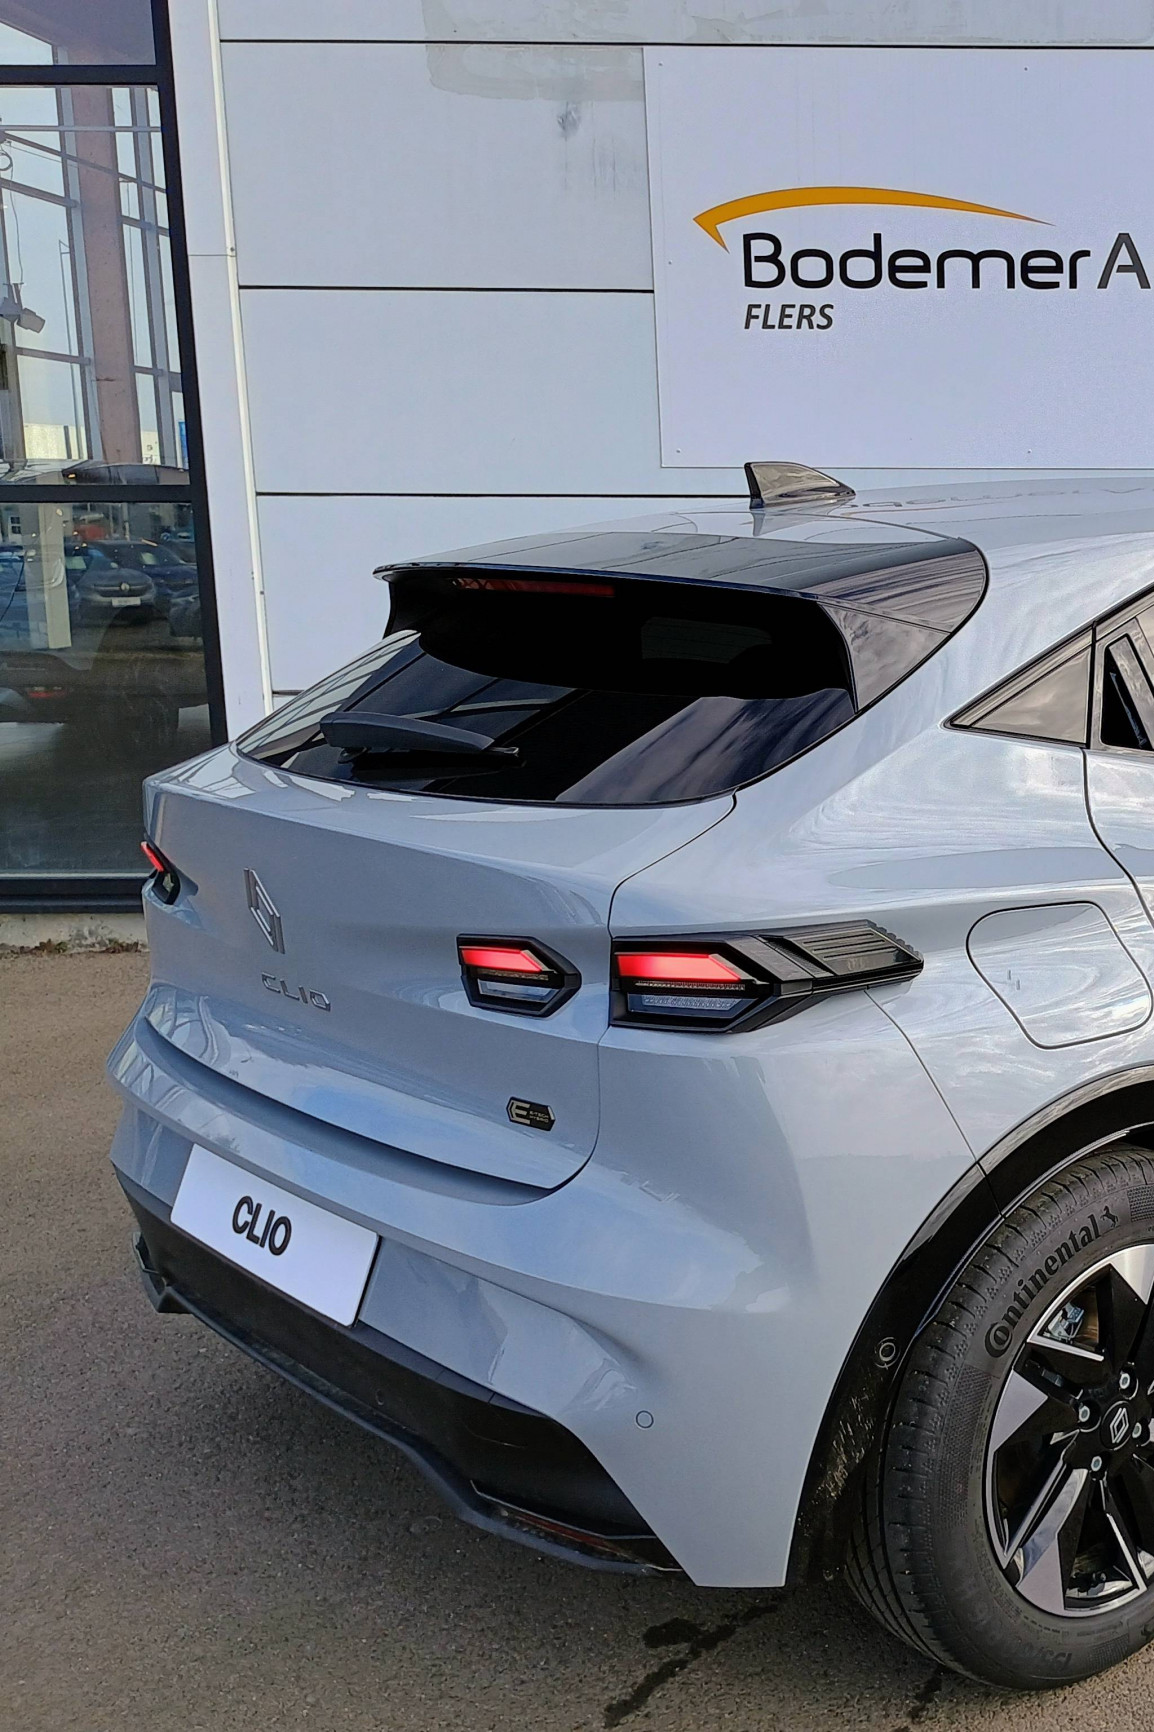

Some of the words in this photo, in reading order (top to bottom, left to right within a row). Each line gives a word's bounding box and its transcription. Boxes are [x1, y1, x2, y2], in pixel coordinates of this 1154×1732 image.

[743, 304, 834, 330] FLERS
[261, 972, 331, 1012] CLIO
[232, 1195, 292, 1257] CLIO
[985, 1213, 1101, 1358] Continental
